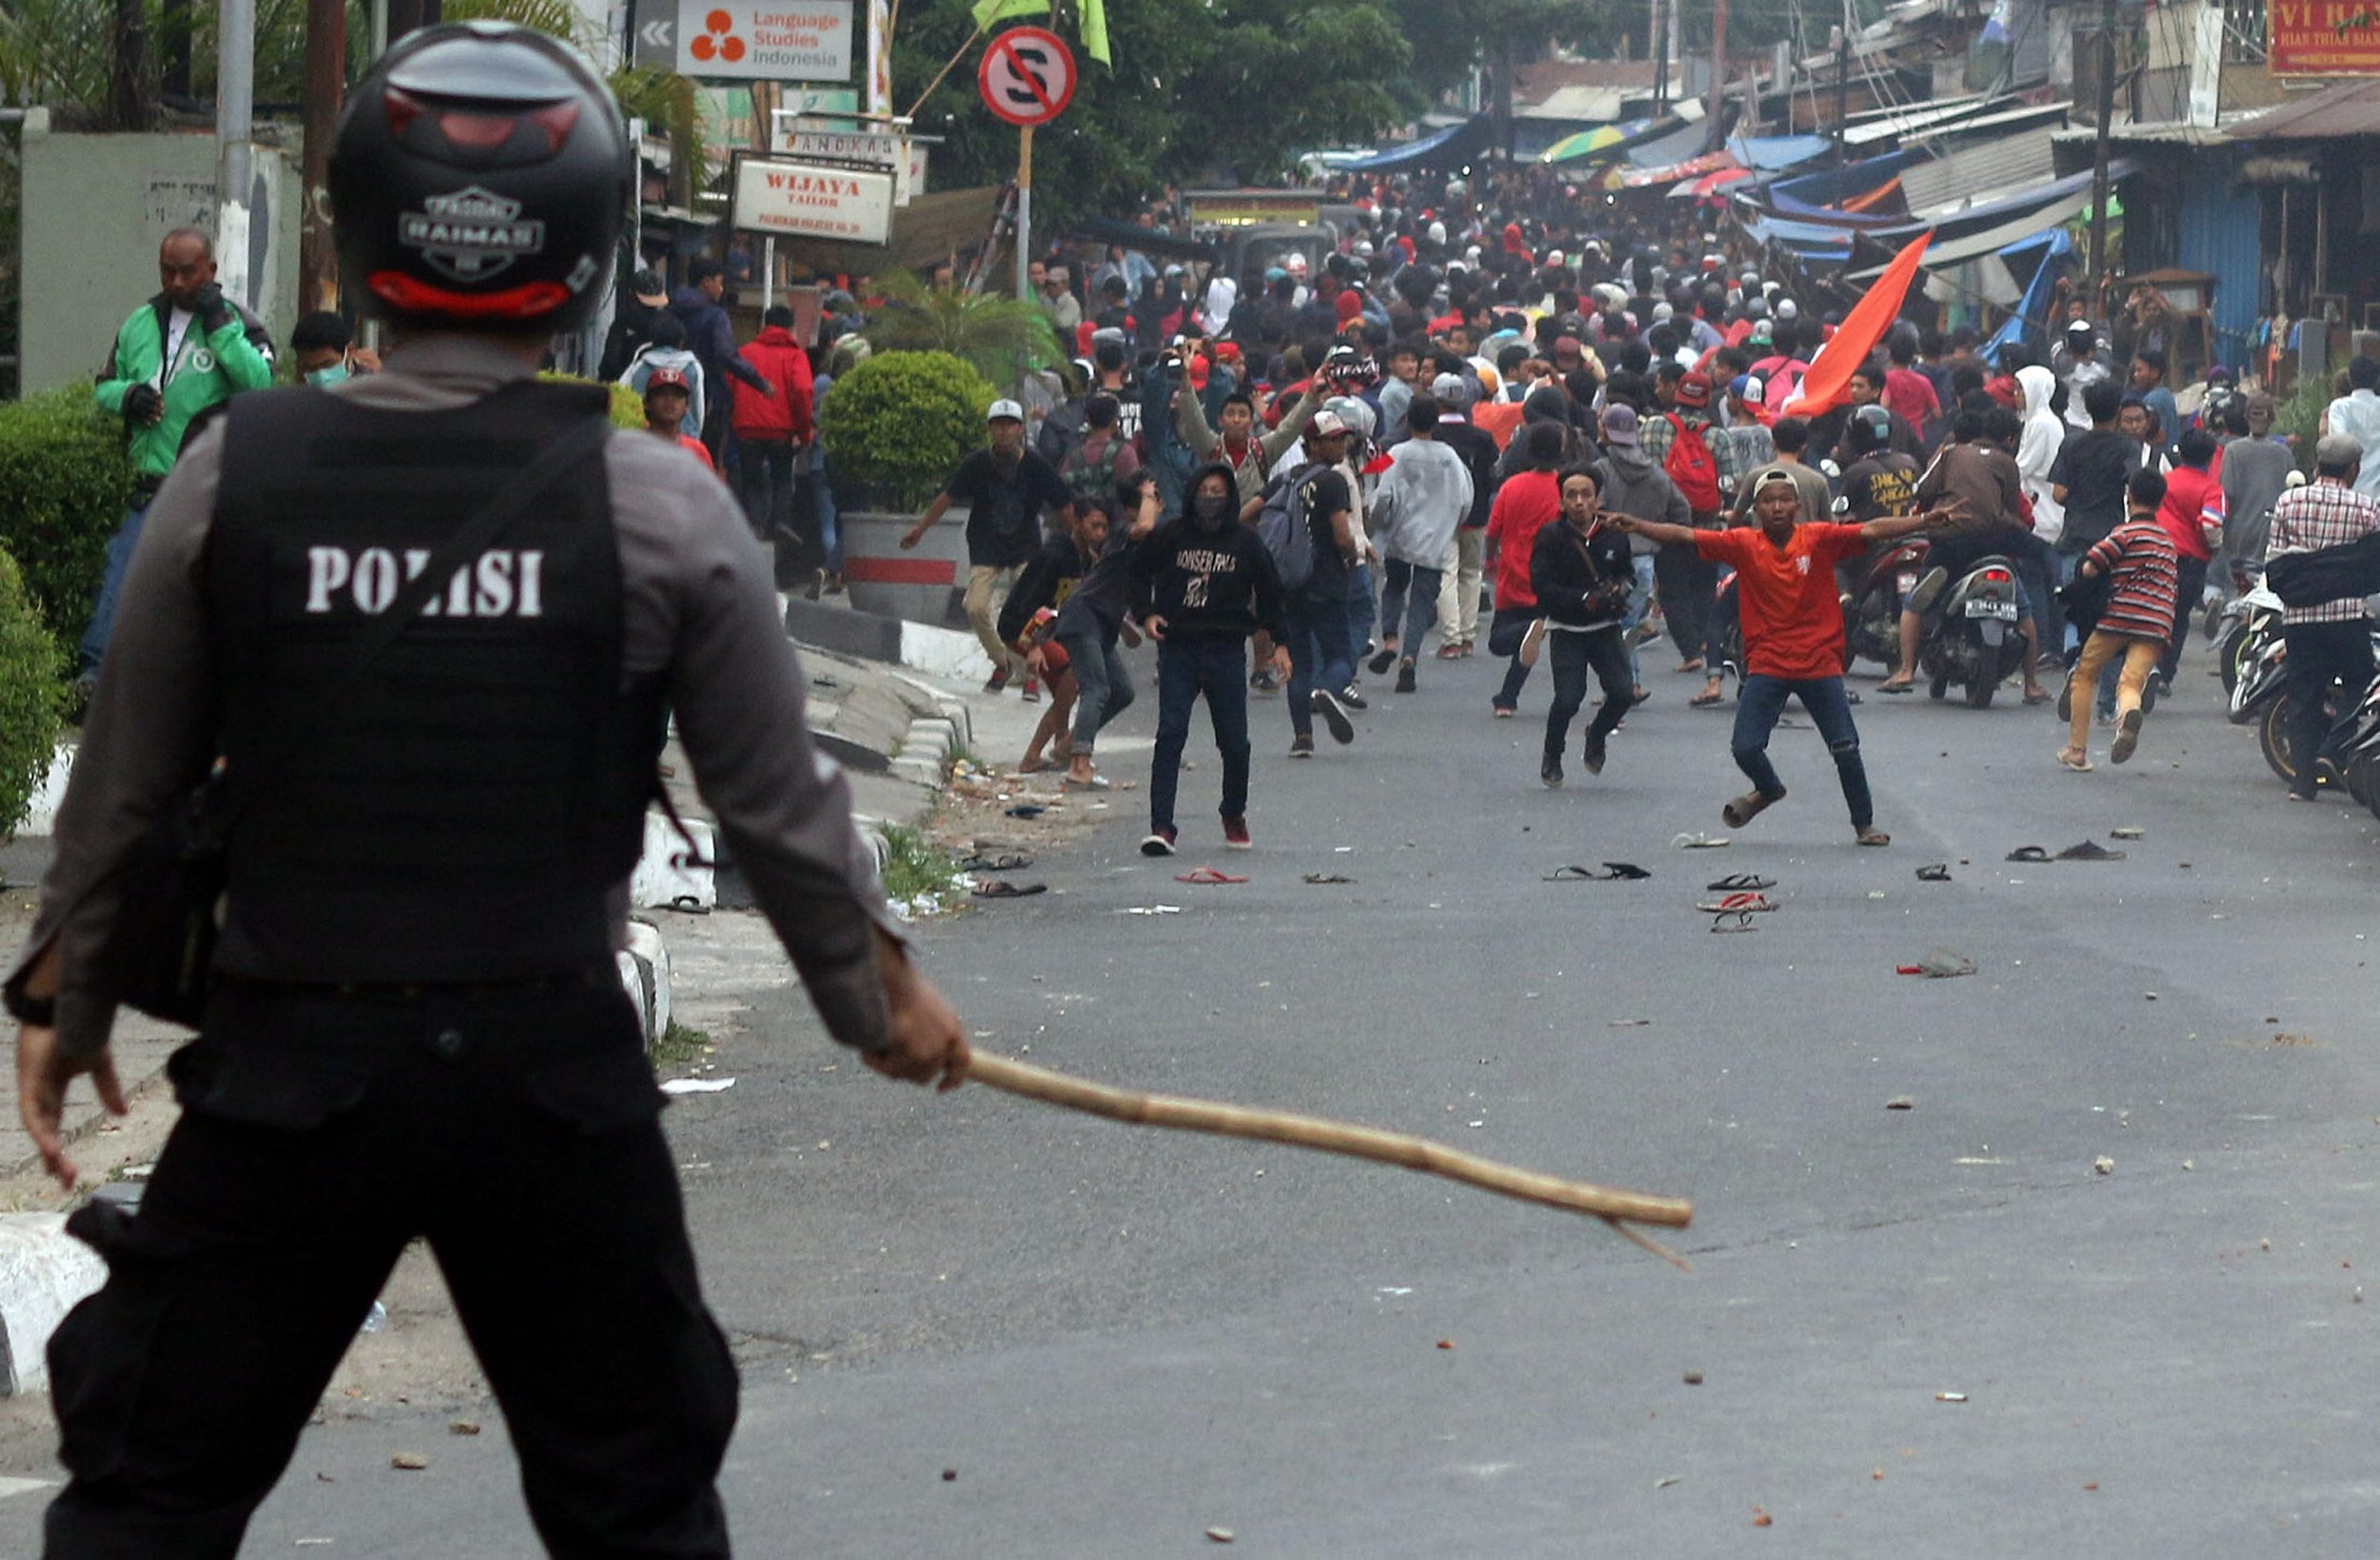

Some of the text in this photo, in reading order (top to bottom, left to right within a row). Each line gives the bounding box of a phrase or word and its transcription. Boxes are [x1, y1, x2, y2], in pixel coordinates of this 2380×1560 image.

[753, 10, 840, 31] Language
[754, 30, 820, 48] Studies
[753, 50, 838, 68] Indonesia
[765, 172, 861, 197] WIJAYA
[786, 193, 839, 208] TAILOR
[407, 221, 533, 245] RAIMAS
